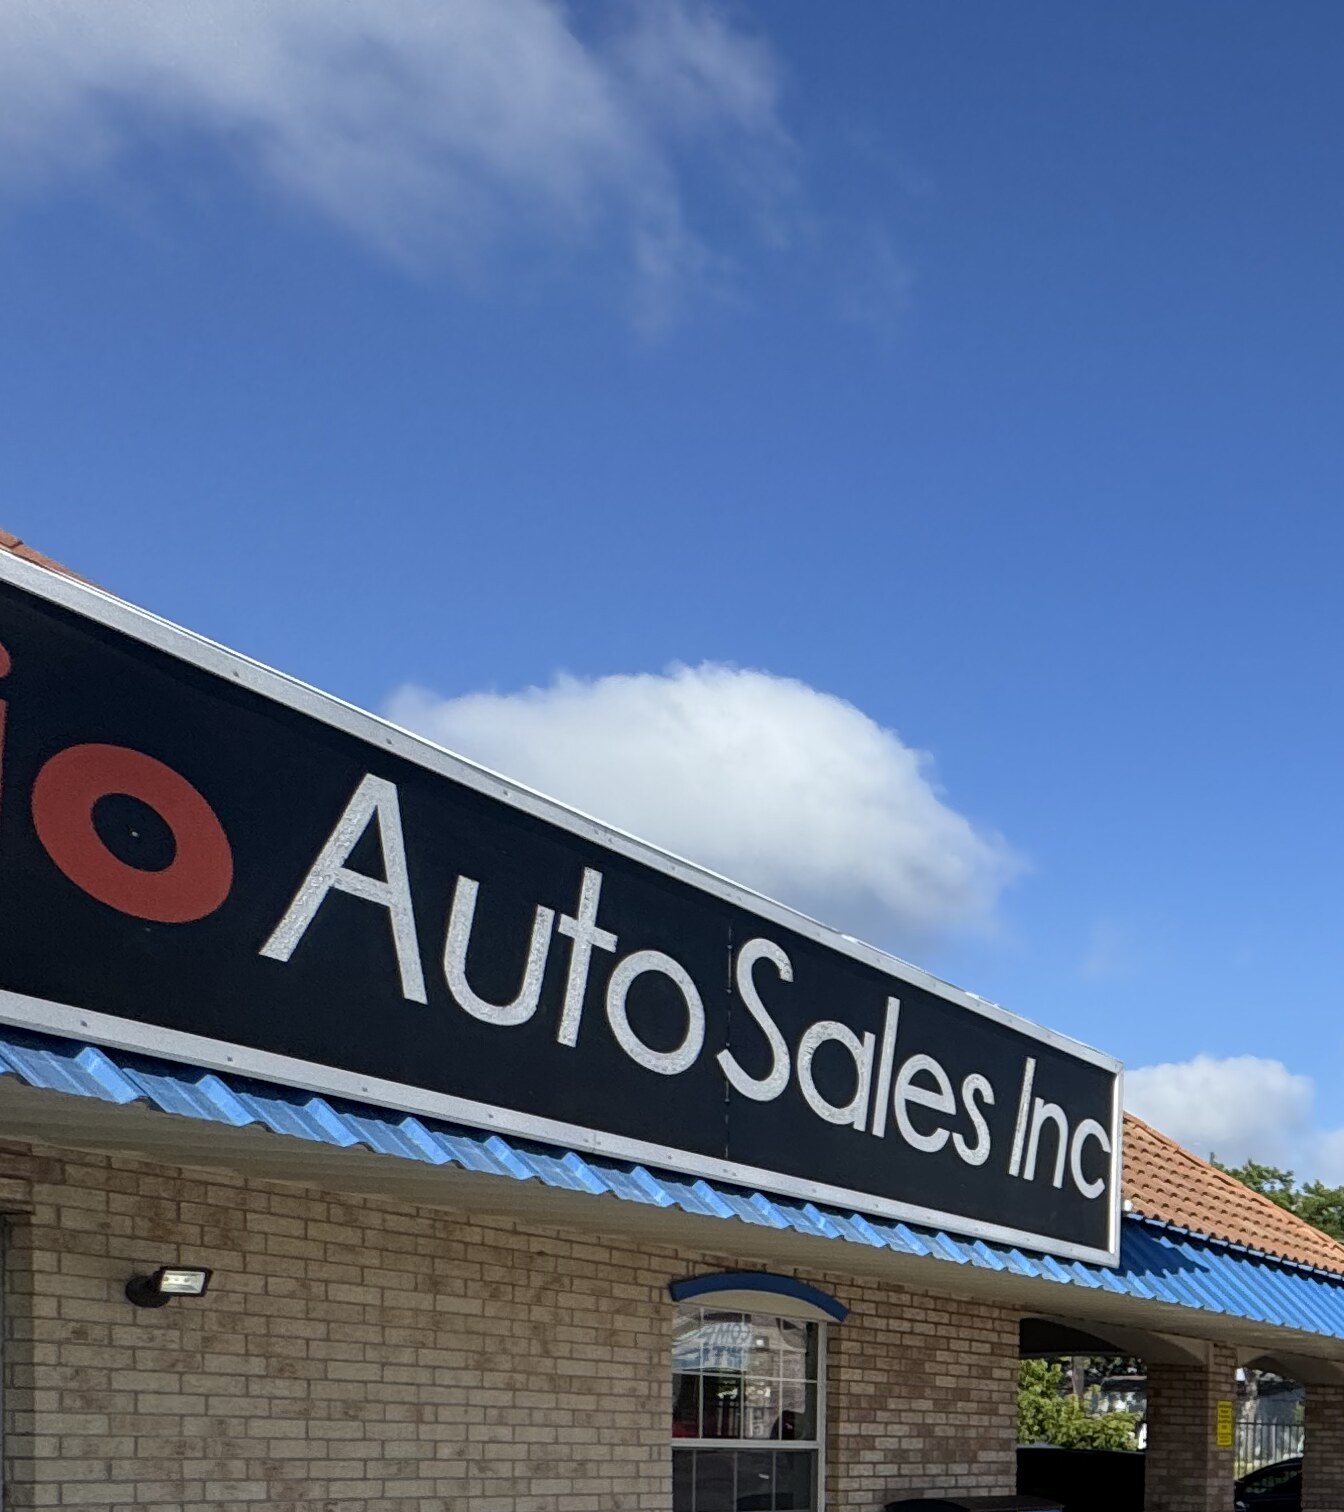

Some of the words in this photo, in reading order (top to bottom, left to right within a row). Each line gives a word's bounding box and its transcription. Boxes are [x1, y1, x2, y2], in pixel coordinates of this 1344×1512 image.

[0, 640, 234, 924] o
[258, 772, 706, 1076] Auto
[716, 937, 996, 1167] Sales
[1008, 1056, 1112, 1200] Inc
